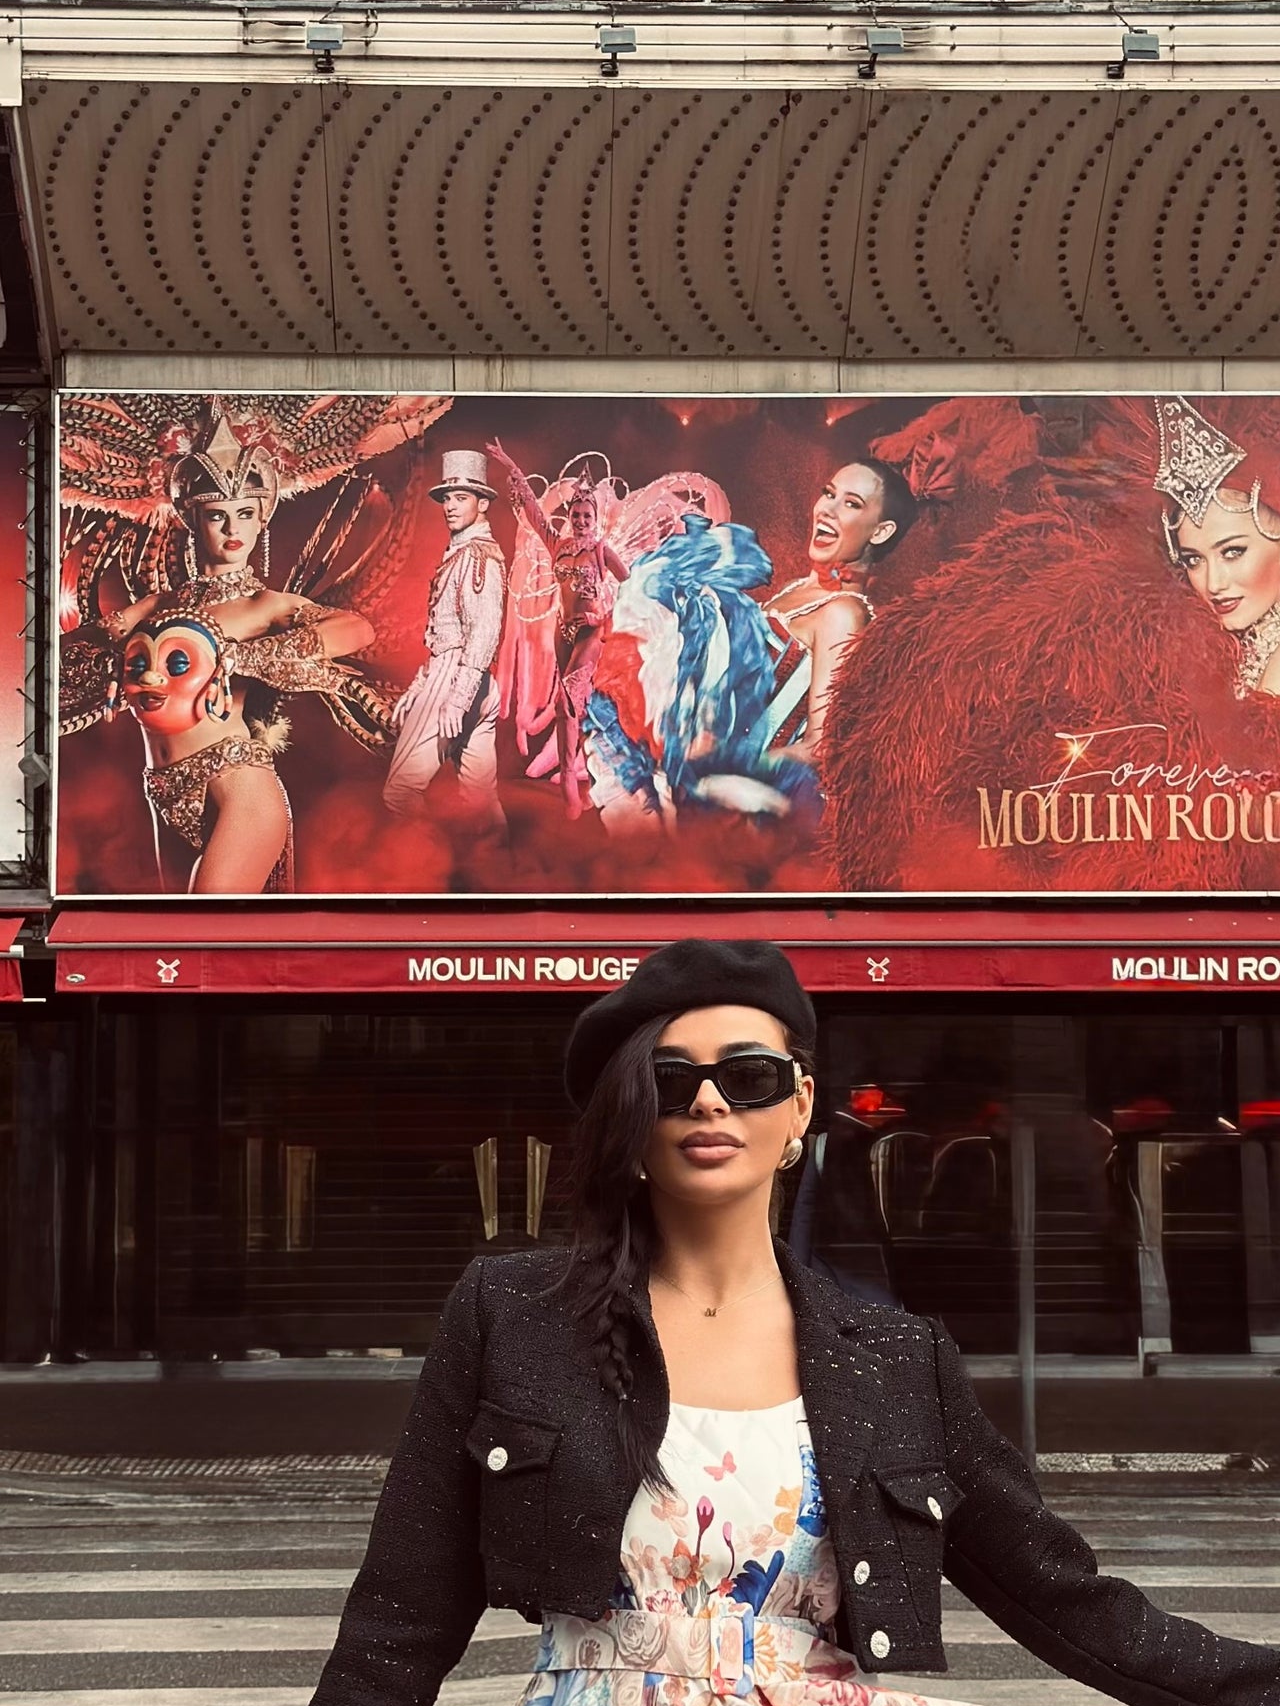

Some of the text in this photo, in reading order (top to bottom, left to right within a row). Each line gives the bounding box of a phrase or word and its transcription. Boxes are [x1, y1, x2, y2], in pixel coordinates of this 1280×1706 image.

[976, 786, 1153, 850] MOULIN
[408, 957, 640, 982] MOULIN ROUGE
[1111, 956, 1229, 981] MOULIN
